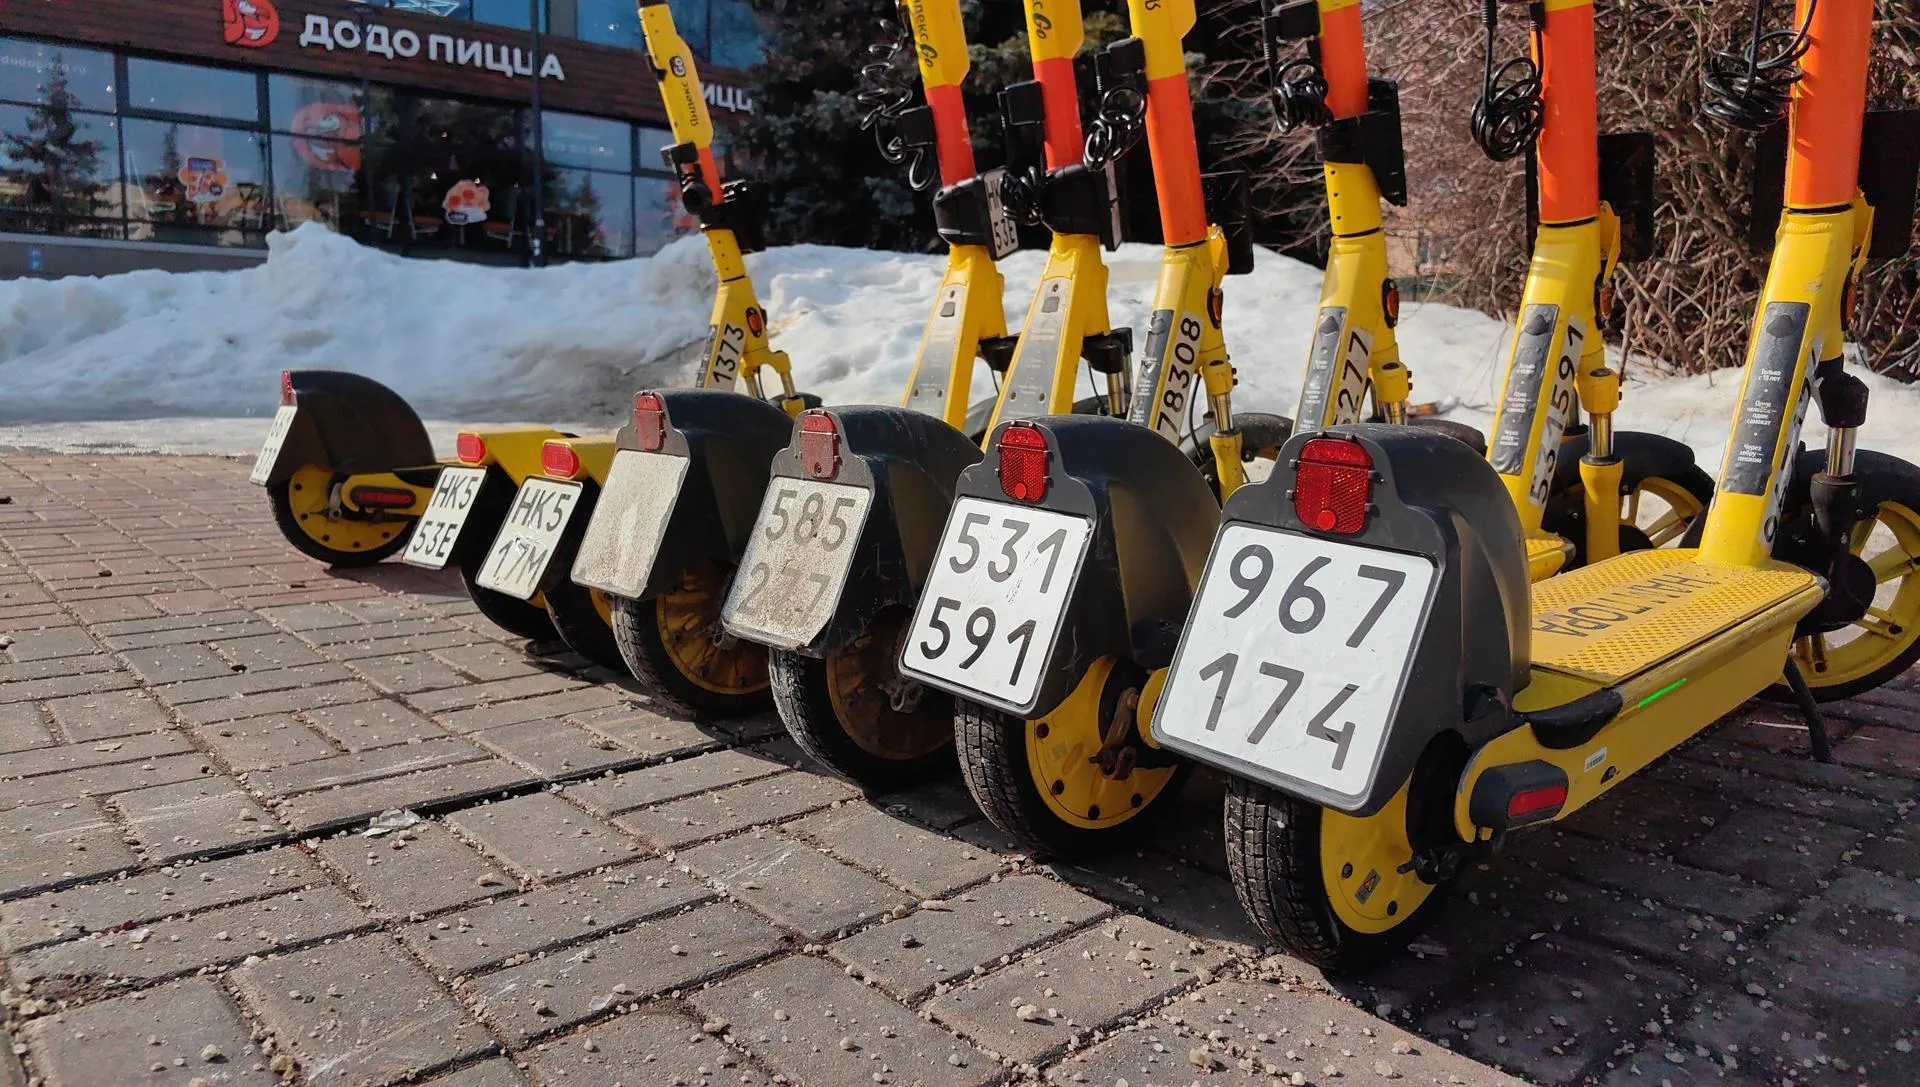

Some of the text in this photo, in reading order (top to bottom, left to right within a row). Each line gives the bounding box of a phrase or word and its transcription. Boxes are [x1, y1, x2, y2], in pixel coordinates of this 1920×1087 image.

[299, 13, 566, 81] ДОДО ПИЦЦА
[920, 44, 938, 68] Go
[1032, 12, 1052, 40] Go
[700, 81, 755, 116] ИЦЦ
[713, 323, 744, 383] 1373
[1157, 317, 1200, 434] 78308
[1333, 331, 1369, 425] 277
[432, 474, 479, 510] HK5
[511, 487, 572, 532] HK5
[765, 489, 856, 552] 585
[413, 520, 458, 558] 53E
[493, 537, 549, 590] 17M
[949, 512, 1068, 594] 531
[1222, 544, 1407, 648] 967
[919, 596, 1037, 687] 591
[1199, 652, 1361, 771] 174
